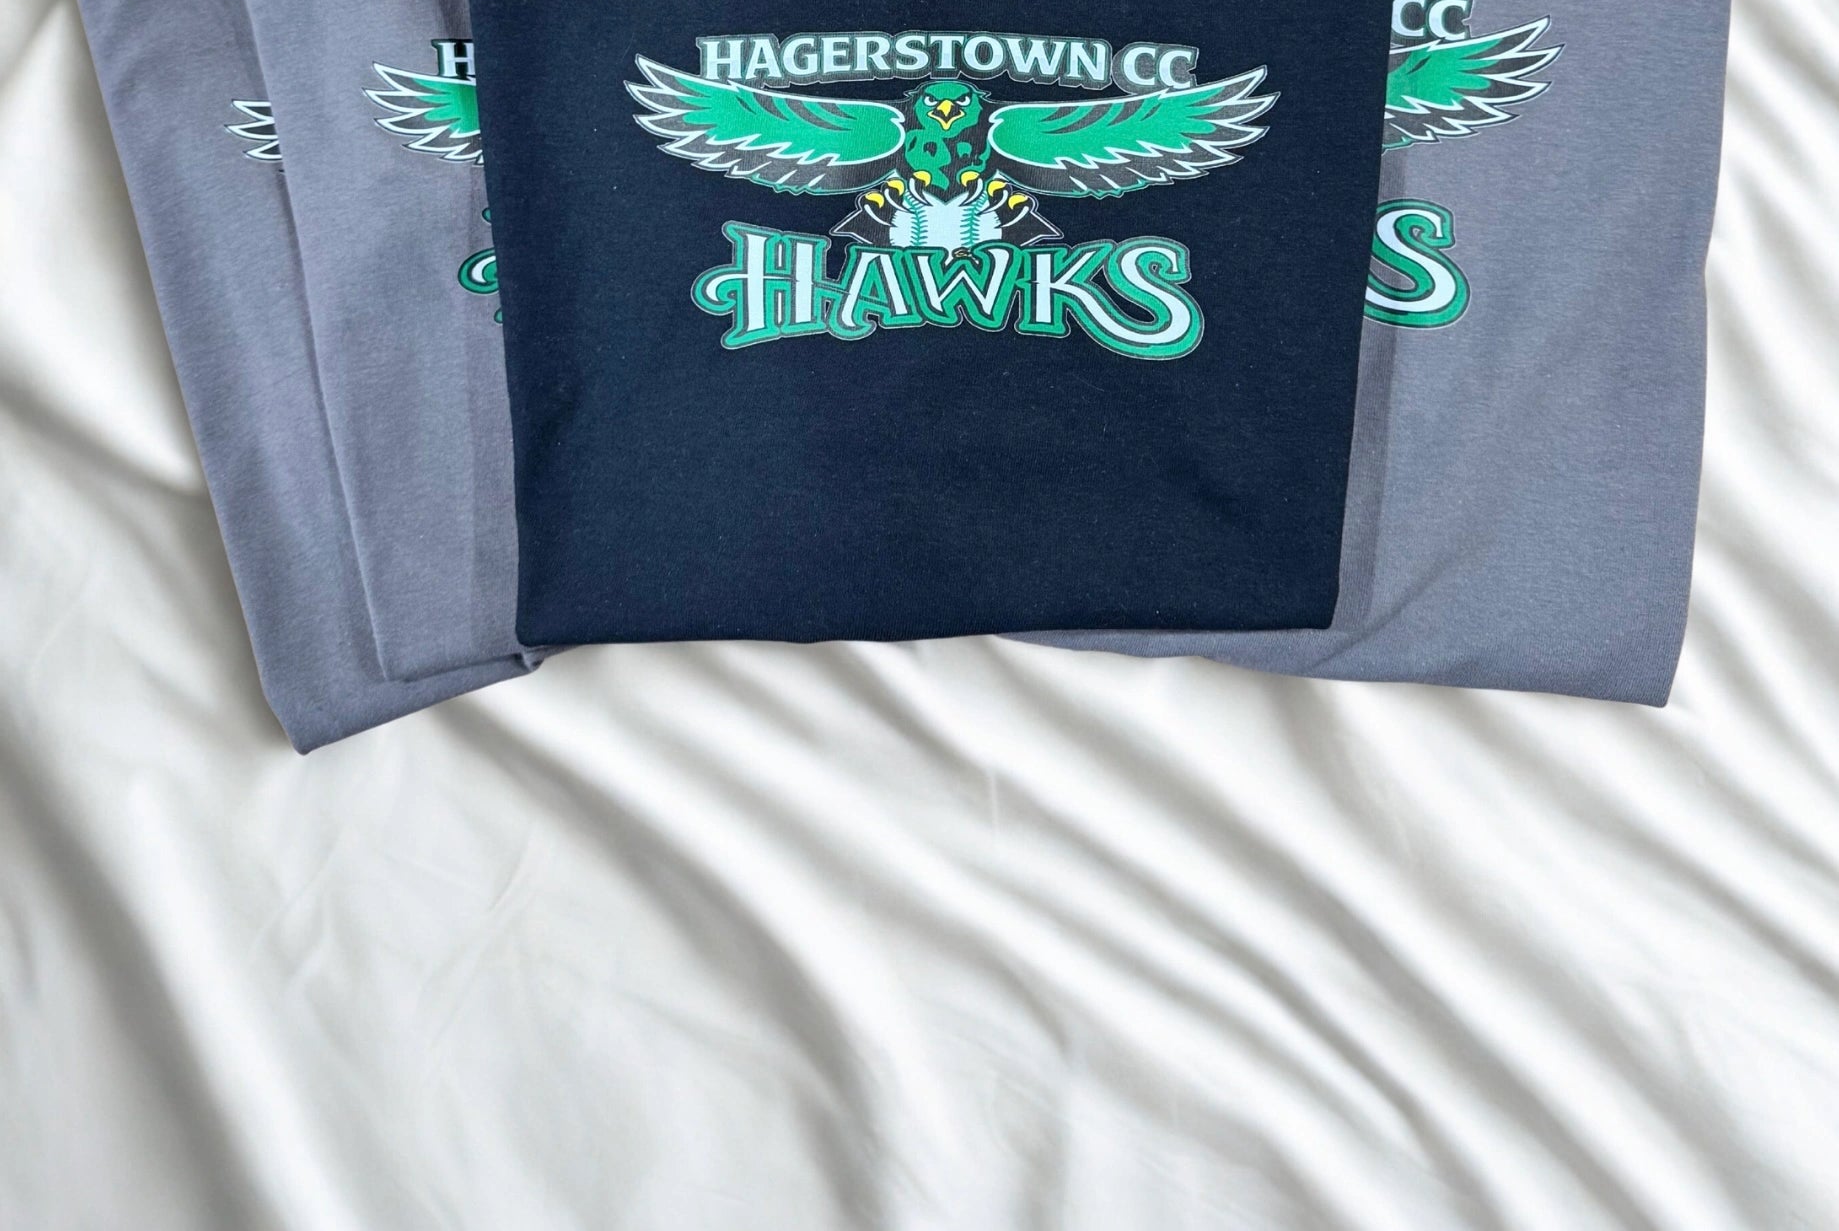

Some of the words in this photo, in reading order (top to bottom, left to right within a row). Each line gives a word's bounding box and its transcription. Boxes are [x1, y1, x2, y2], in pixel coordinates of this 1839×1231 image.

[699, 33, 1109, 85] HAGERSTOWN
[1120, 43, 1198, 89] CC
[692, 222, 1204, 360] HAWKS
